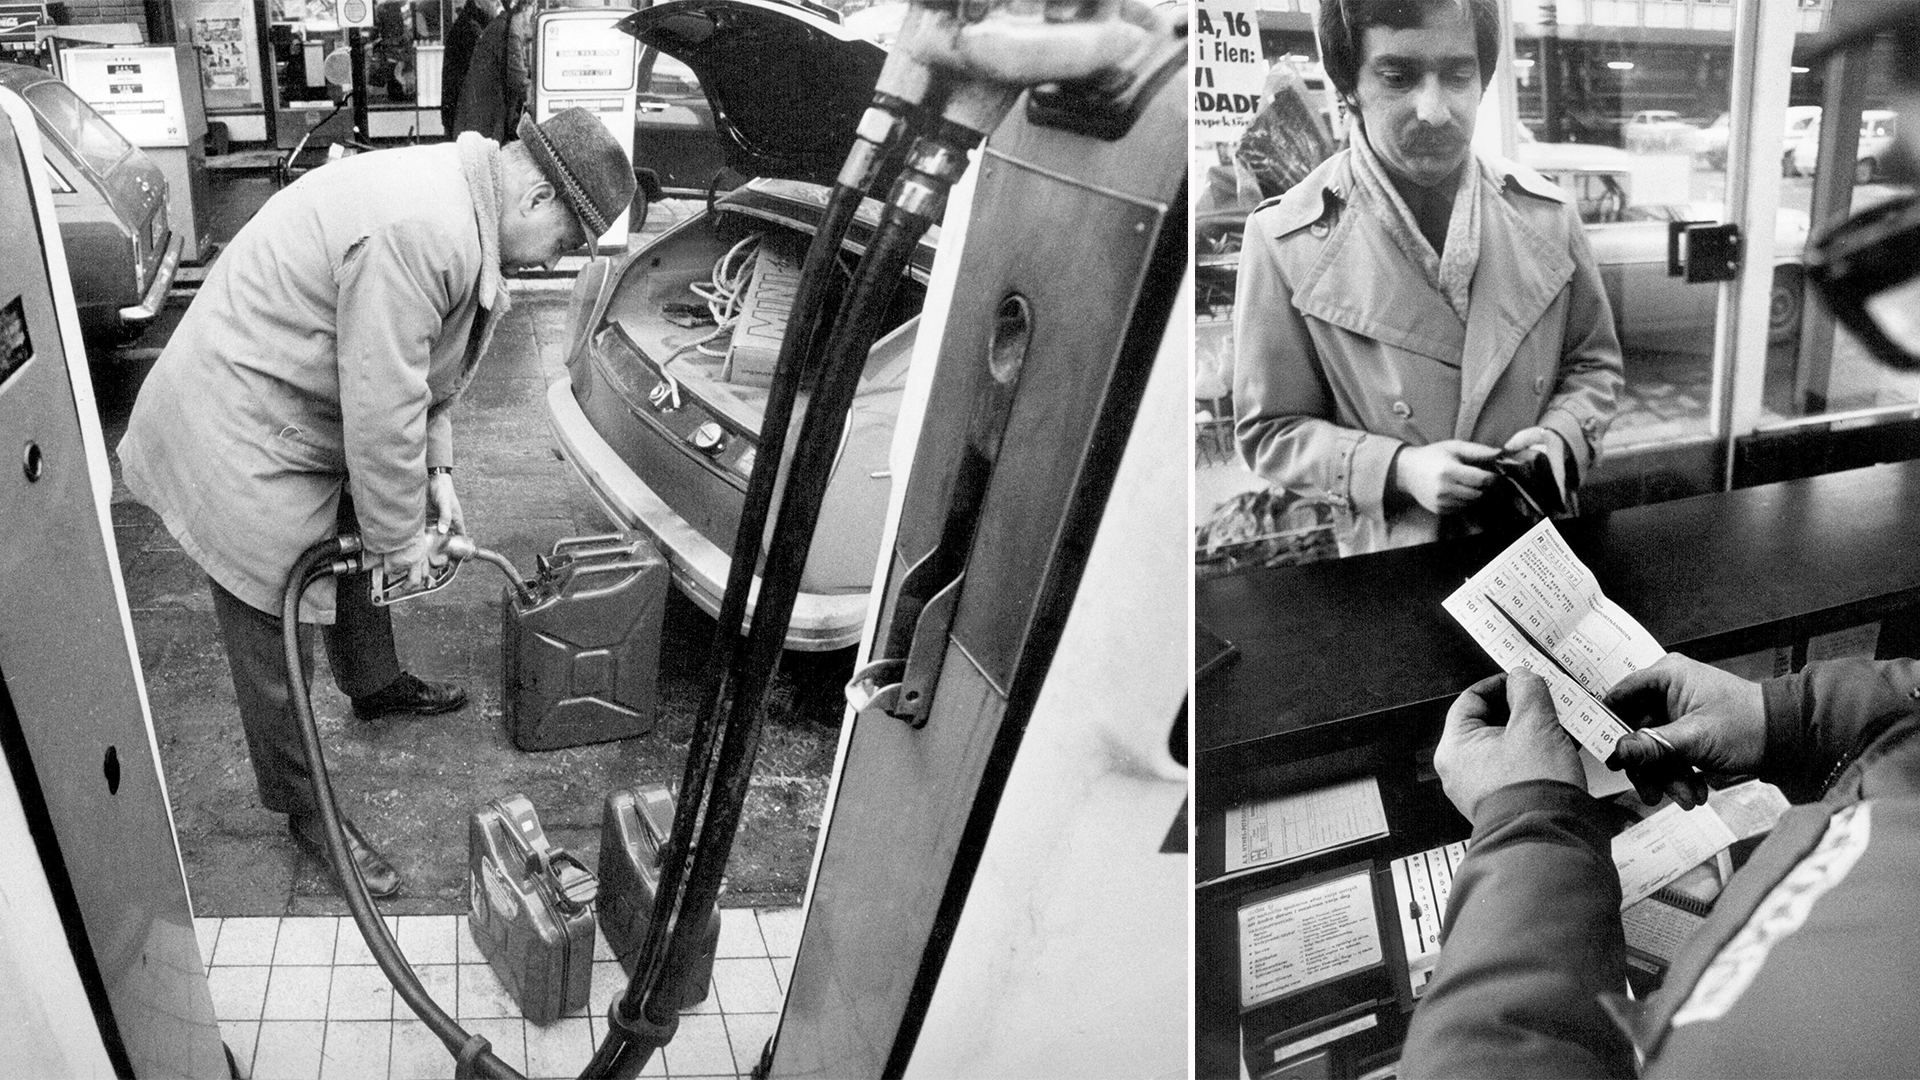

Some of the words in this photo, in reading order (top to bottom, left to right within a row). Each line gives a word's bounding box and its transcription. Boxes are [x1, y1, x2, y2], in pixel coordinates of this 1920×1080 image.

[1199, 39, 1204, 60] i
[1215, 42, 1254, 64] Flen:
[1195, 92, 1260, 113] DAD
[1536, 536, 1545, 544] R
[1493, 576, 1507, 589] 101
[1511, 595, 1524, 609] 101
[1528, 615, 1541, 628] 101
[1545, 635, 1556, 648] 101
[1561, 654, 1574, 666] 101
[1578, 672, 1590, 686] 101
[1593, 691, 1604, 702] 10
[1465, 600, 1478, 613] 101
[1484, 620, 1497, 632] 101
[1502, 638, 1515, 652] 101
[1521, 658, 1534, 671] 101
[1559, 693, 1573, 707] 101
[1579, 711, 1593, 726] 101
[1599, 730, 1614, 745] 101
[1430, 935, 1435, 943] 0
